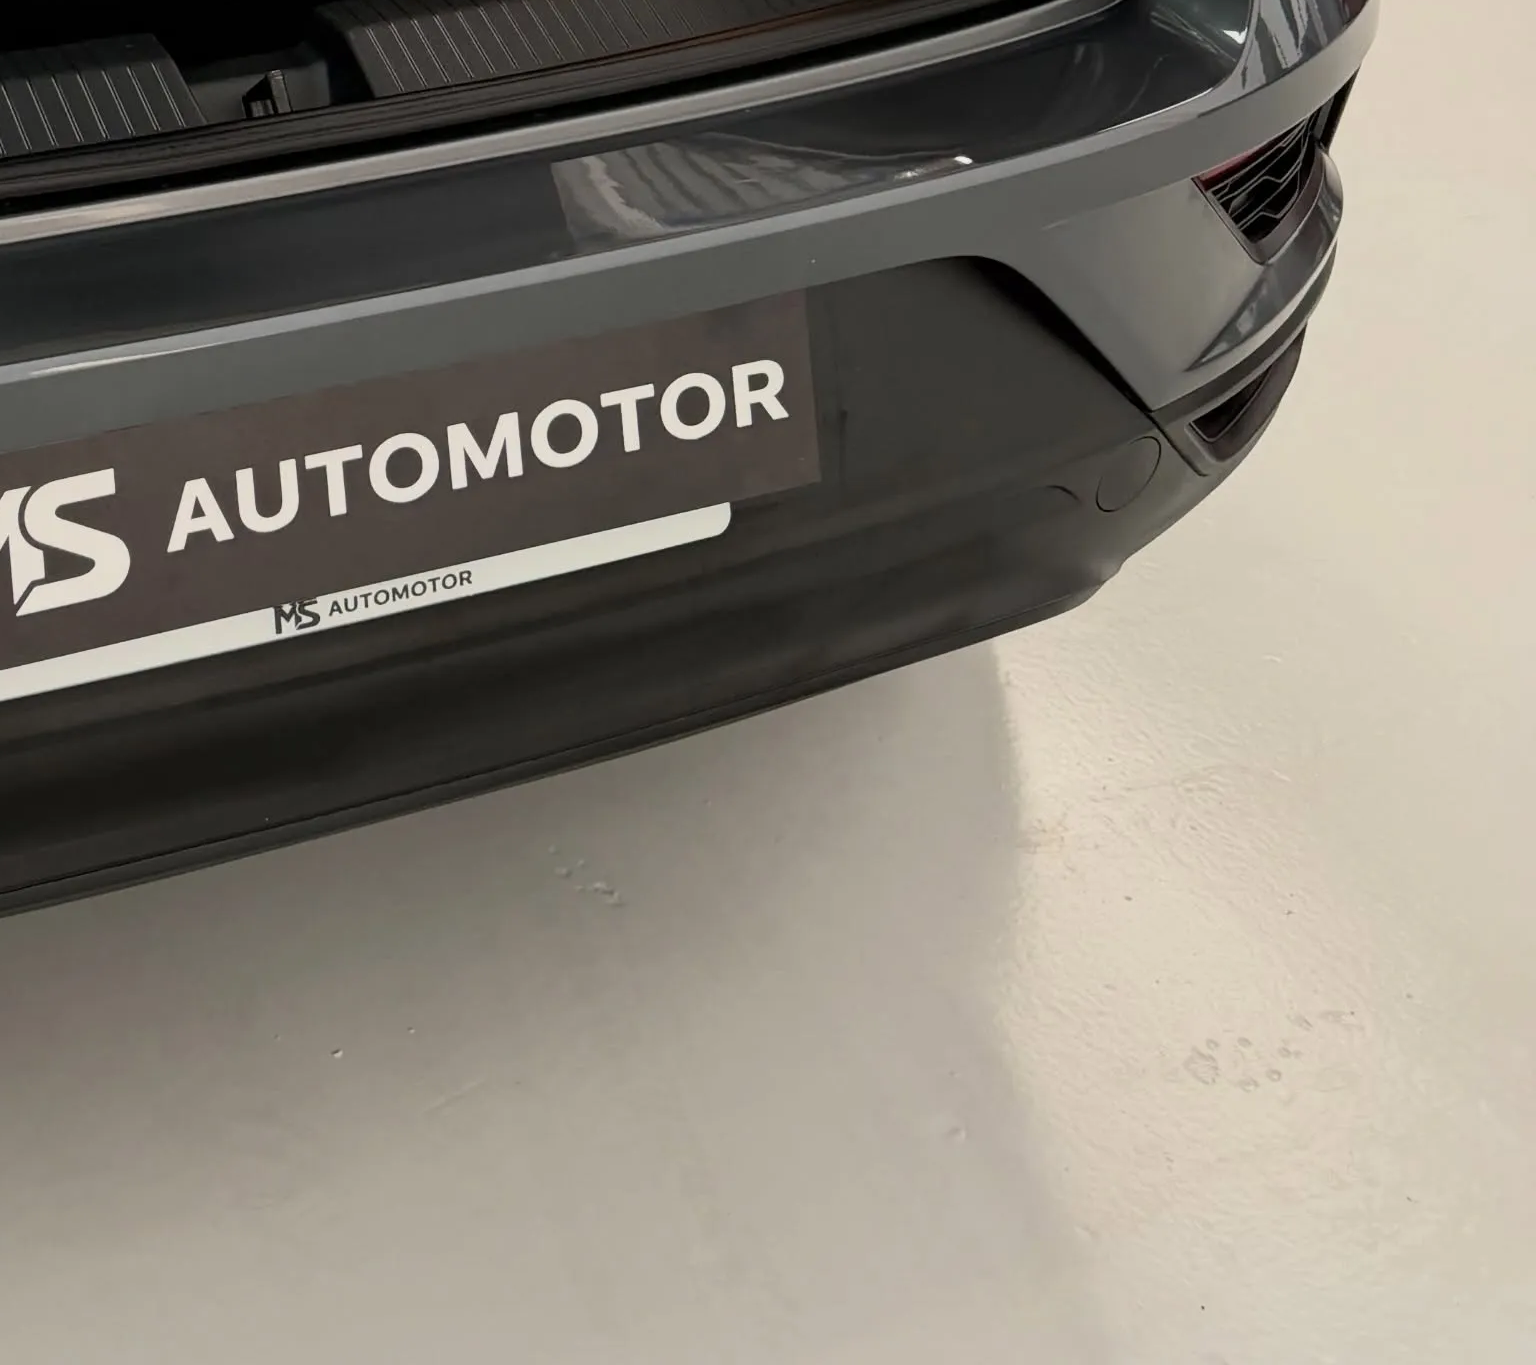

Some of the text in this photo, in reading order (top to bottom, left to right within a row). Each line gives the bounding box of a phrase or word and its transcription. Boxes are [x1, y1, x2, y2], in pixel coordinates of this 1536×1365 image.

[167, 359, 789, 553] AUTOMOTOR
[272, 570, 473, 634] MS AUTOMOTOR
